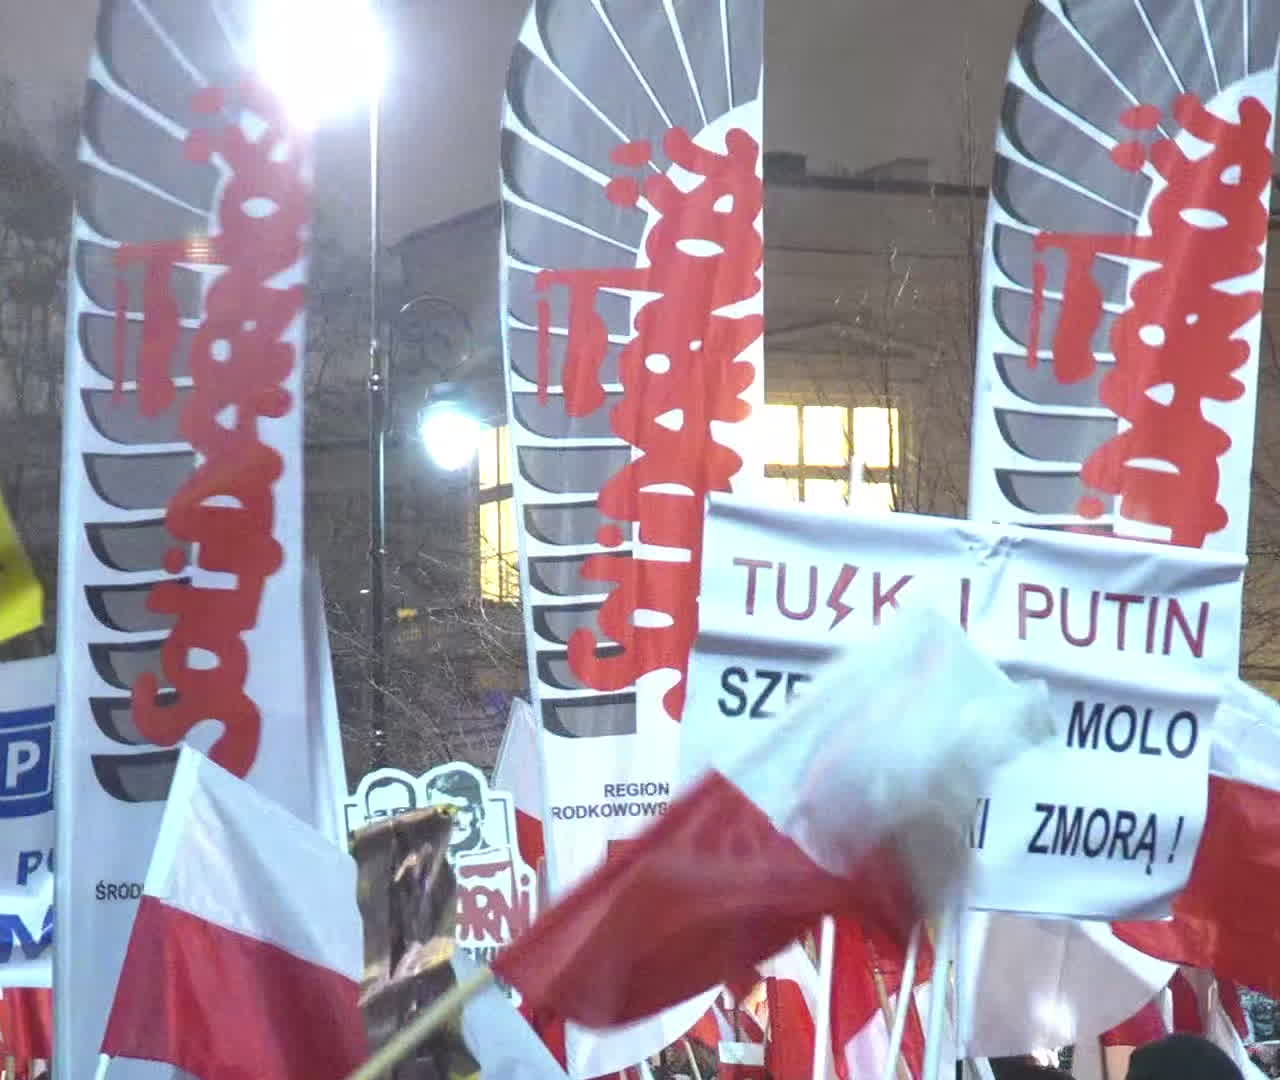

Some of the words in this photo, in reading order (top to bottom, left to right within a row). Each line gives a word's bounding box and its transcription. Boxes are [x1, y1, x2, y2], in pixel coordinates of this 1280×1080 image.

[1017, 582, 1211, 659] PUTIN
[1066, 700, 1199, 760] MOLO
[603, 782, 670, 798] REGION
